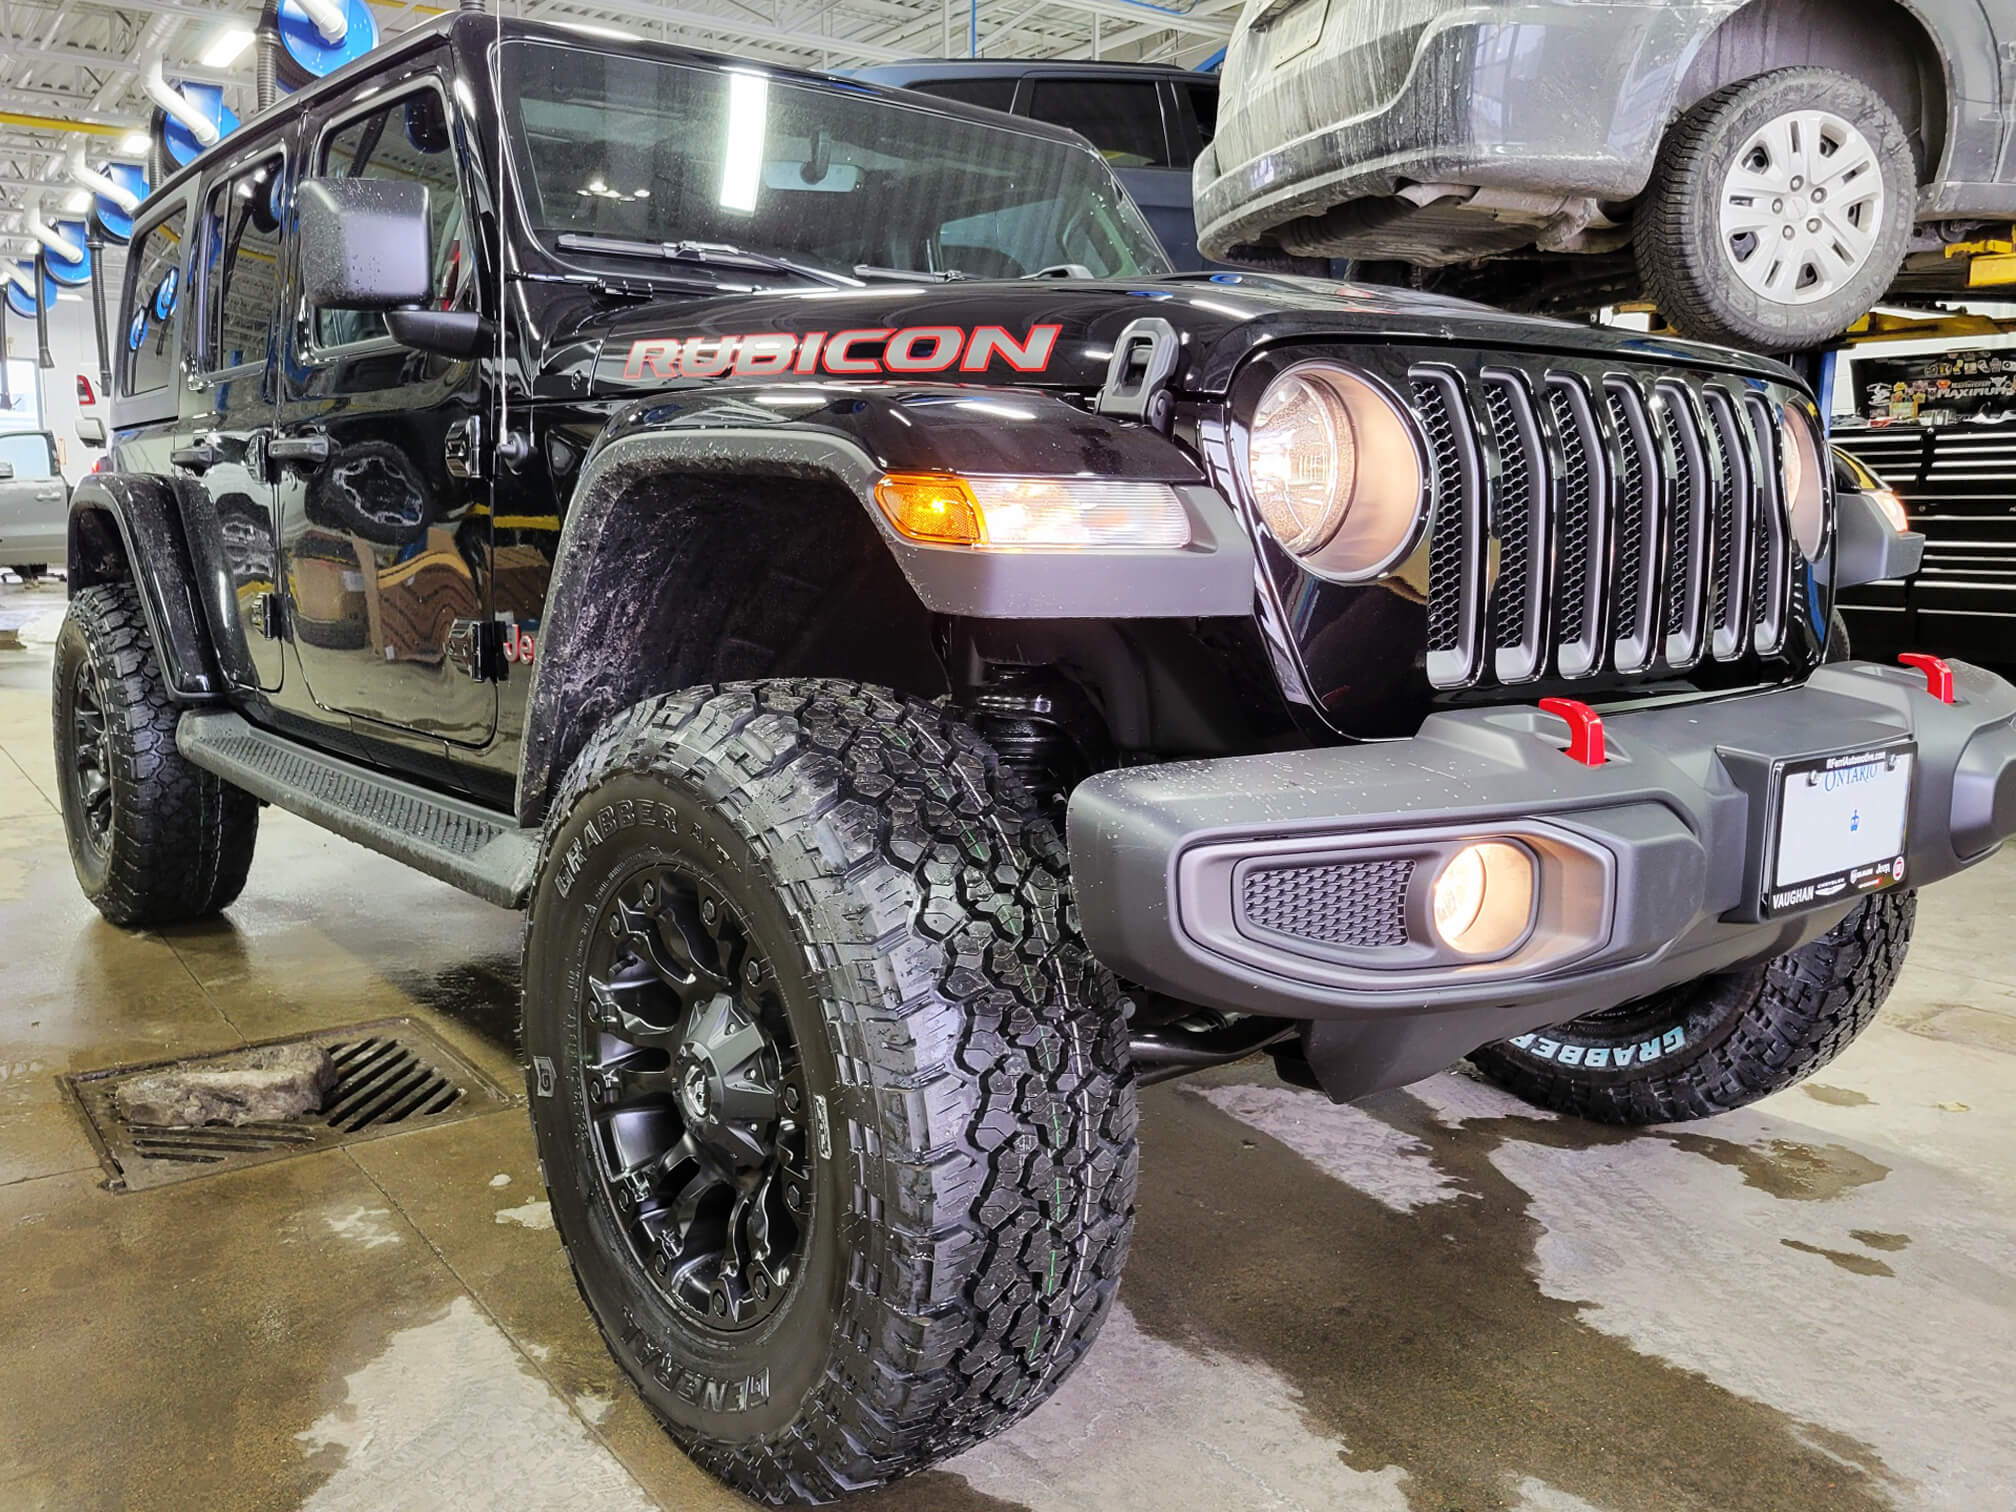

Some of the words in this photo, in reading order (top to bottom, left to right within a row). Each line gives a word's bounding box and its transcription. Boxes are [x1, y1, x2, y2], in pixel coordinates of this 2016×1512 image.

[623, 323, 1063, 380] RUBICON
[1824, 765, 1878, 791] ONTARIO
[554, 798, 679, 898] GRABBER
[1772, 885, 1815, 910] VAUGHAN
[1508, 1025, 1687, 1068] GRABBER
